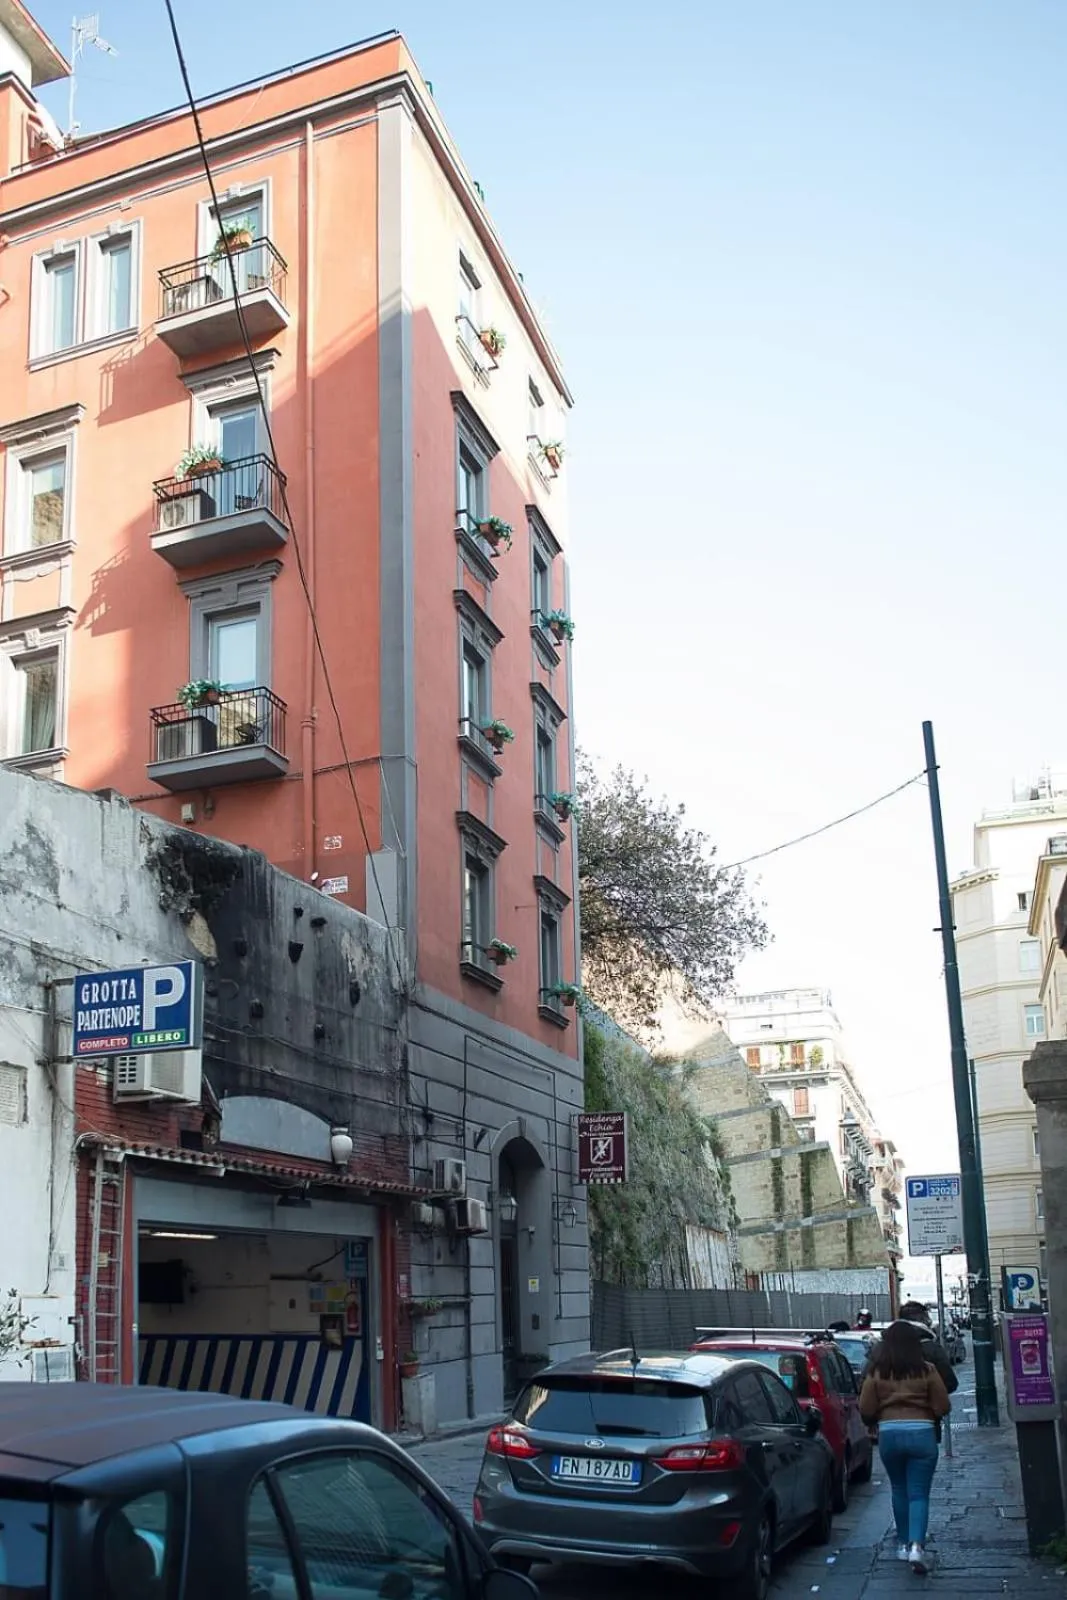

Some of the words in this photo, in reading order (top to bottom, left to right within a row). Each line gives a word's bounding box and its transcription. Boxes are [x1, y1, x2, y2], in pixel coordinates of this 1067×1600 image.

[81, 978, 137, 1004] GROTTA
[142, 966, 185, 1031] P
[77, 1004, 141, 1033] PARTENOPE
[79, 1037, 128, 1050] COMPLETO
[137, 1032, 181, 1044] LIBERO
[912, 1182, 924, 1196] P
[561, 1458, 579, 1474] FN
[587, 1460, 631, 1479] 187AD
